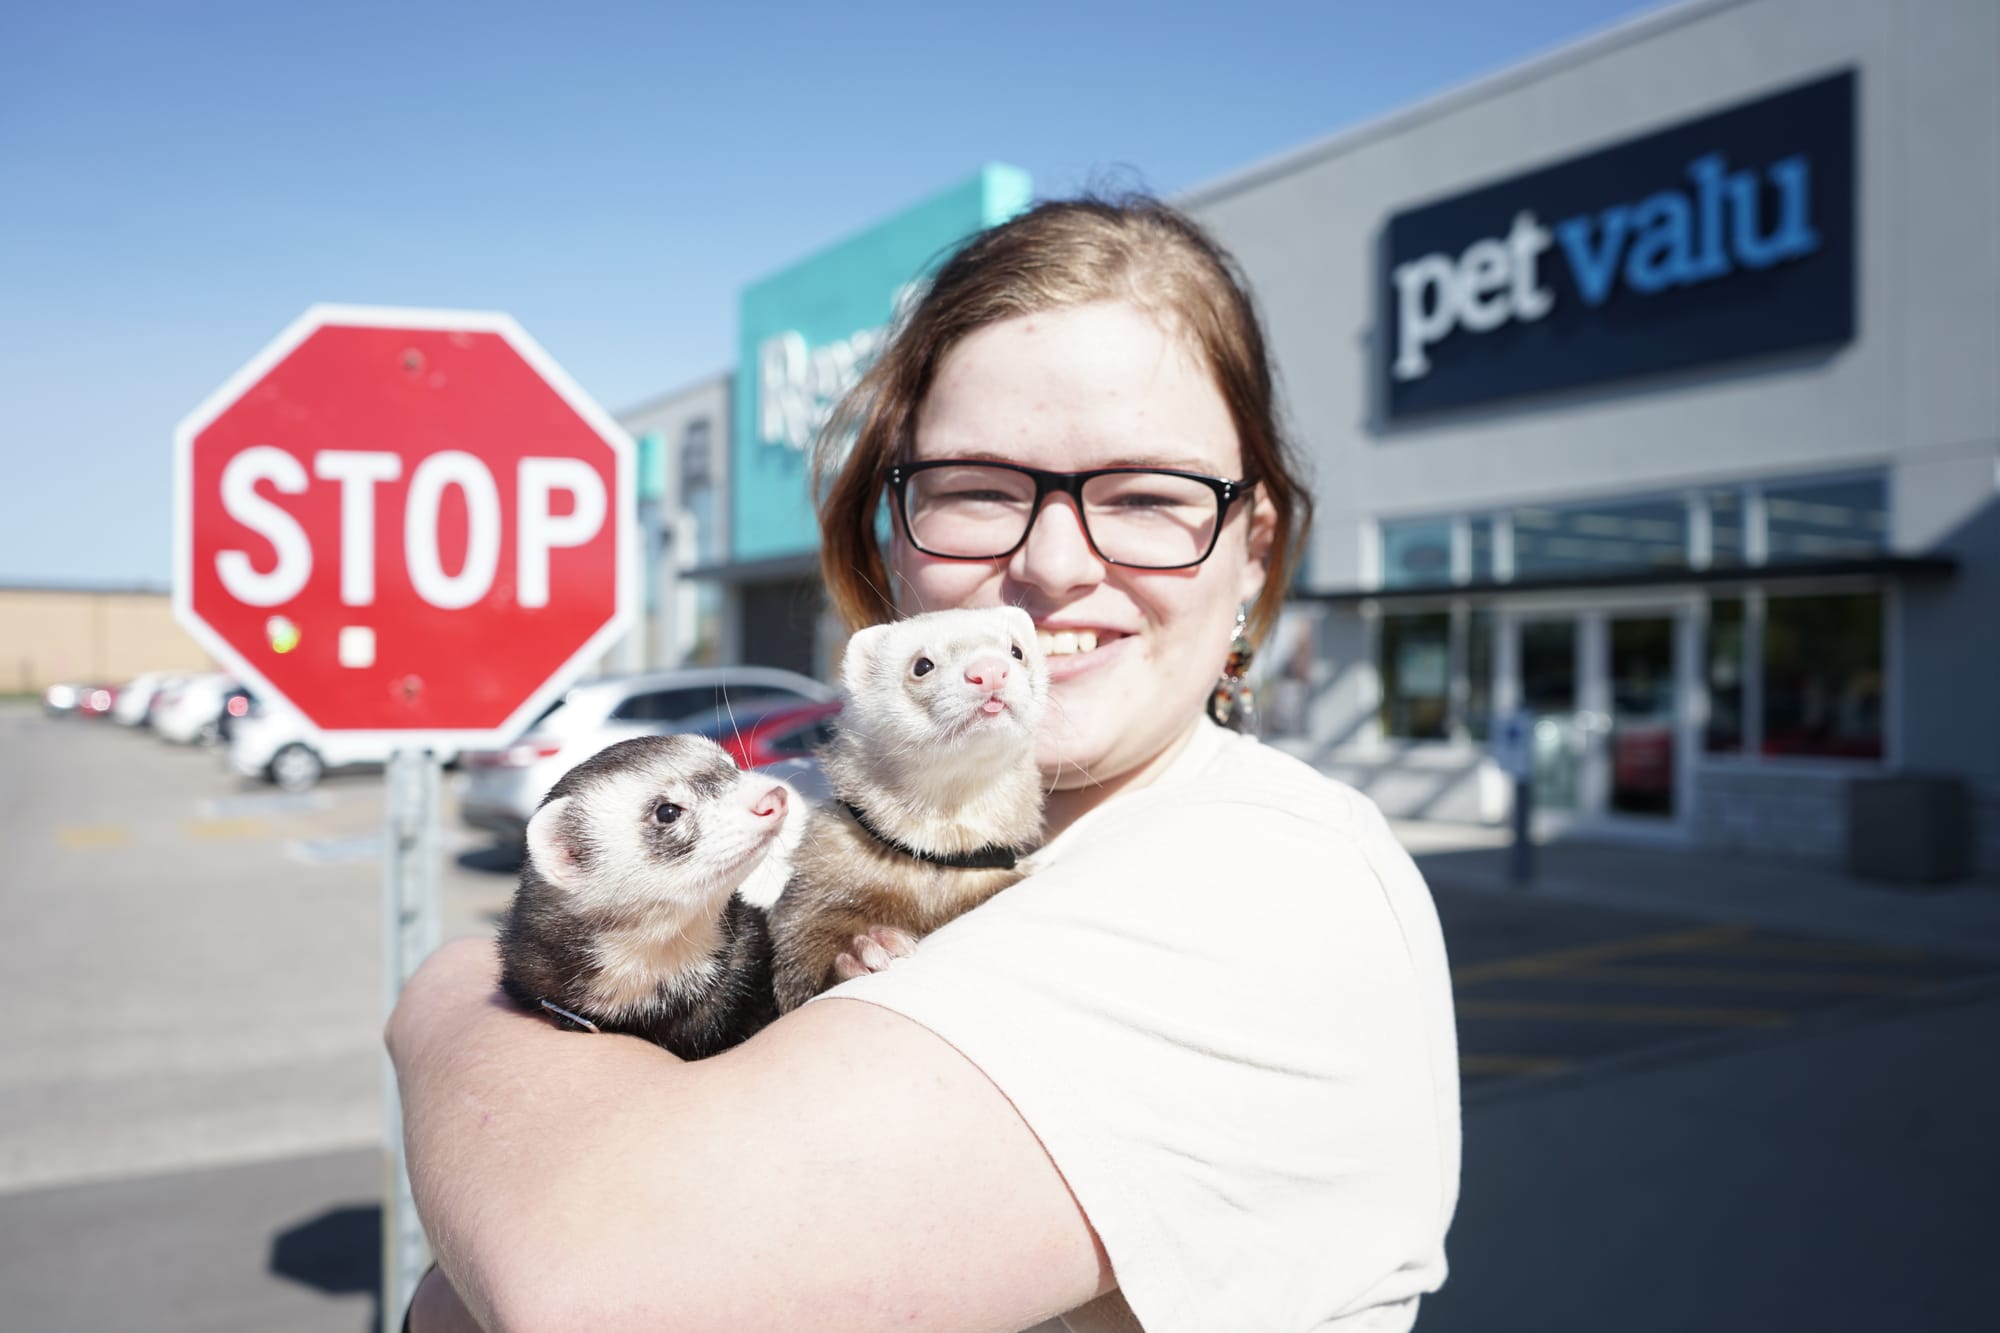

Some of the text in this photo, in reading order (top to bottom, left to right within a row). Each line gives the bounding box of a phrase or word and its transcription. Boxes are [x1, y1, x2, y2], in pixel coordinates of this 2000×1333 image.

[1394, 155, 1818, 380] pet valu
[215, 445, 607, 610] STOP
